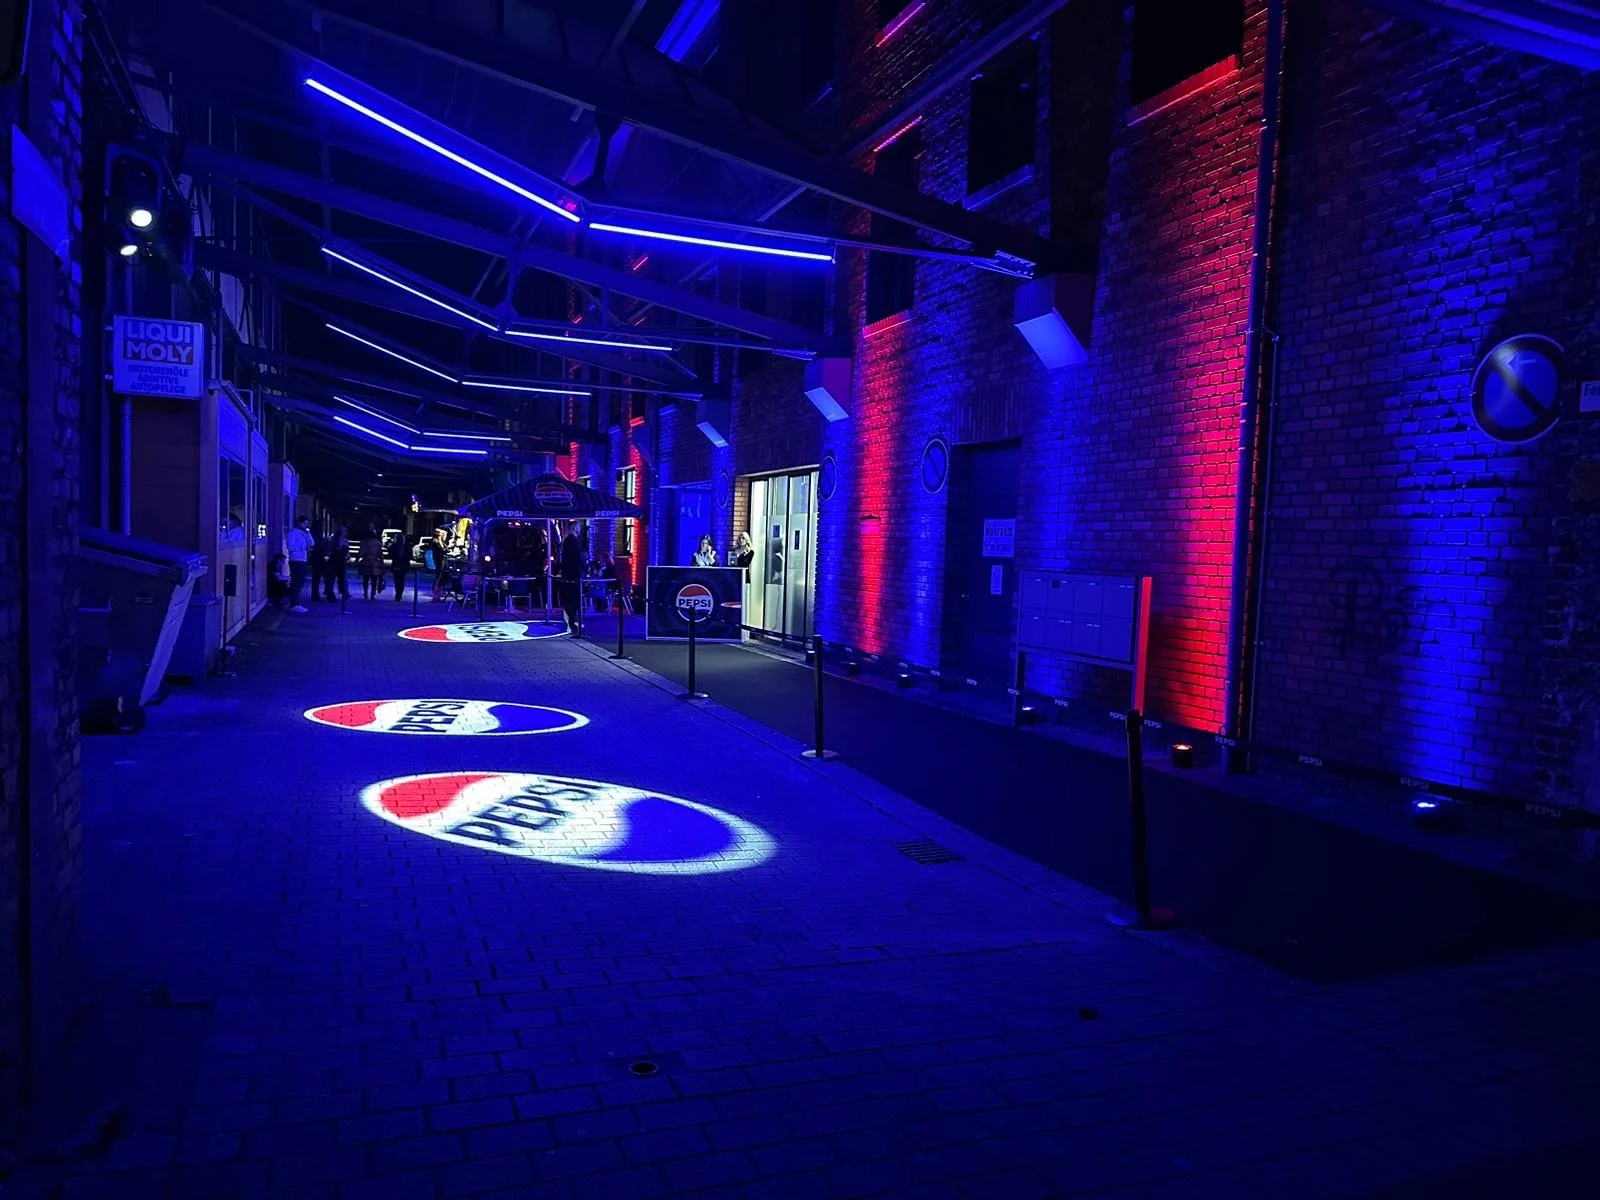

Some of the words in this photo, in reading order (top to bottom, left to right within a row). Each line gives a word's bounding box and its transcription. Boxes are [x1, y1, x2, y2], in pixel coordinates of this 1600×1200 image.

[126, 320, 191, 344] LIQUI
[126, 341, 192, 363] MOLY
[496, 510, 524, 518] PEPSI
[595, 510, 619, 518] PEPSI
[678, 598, 711, 608] PEPSI
[389, 700, 467, 733] PEPSI
[1298, 754, 1322, 767] PEPSI
[1400, 776, 1430, 790] PEPSI
[446, 778, 602, 847] PEPSI
[1525, 803, 1561, 819] PEPSI
